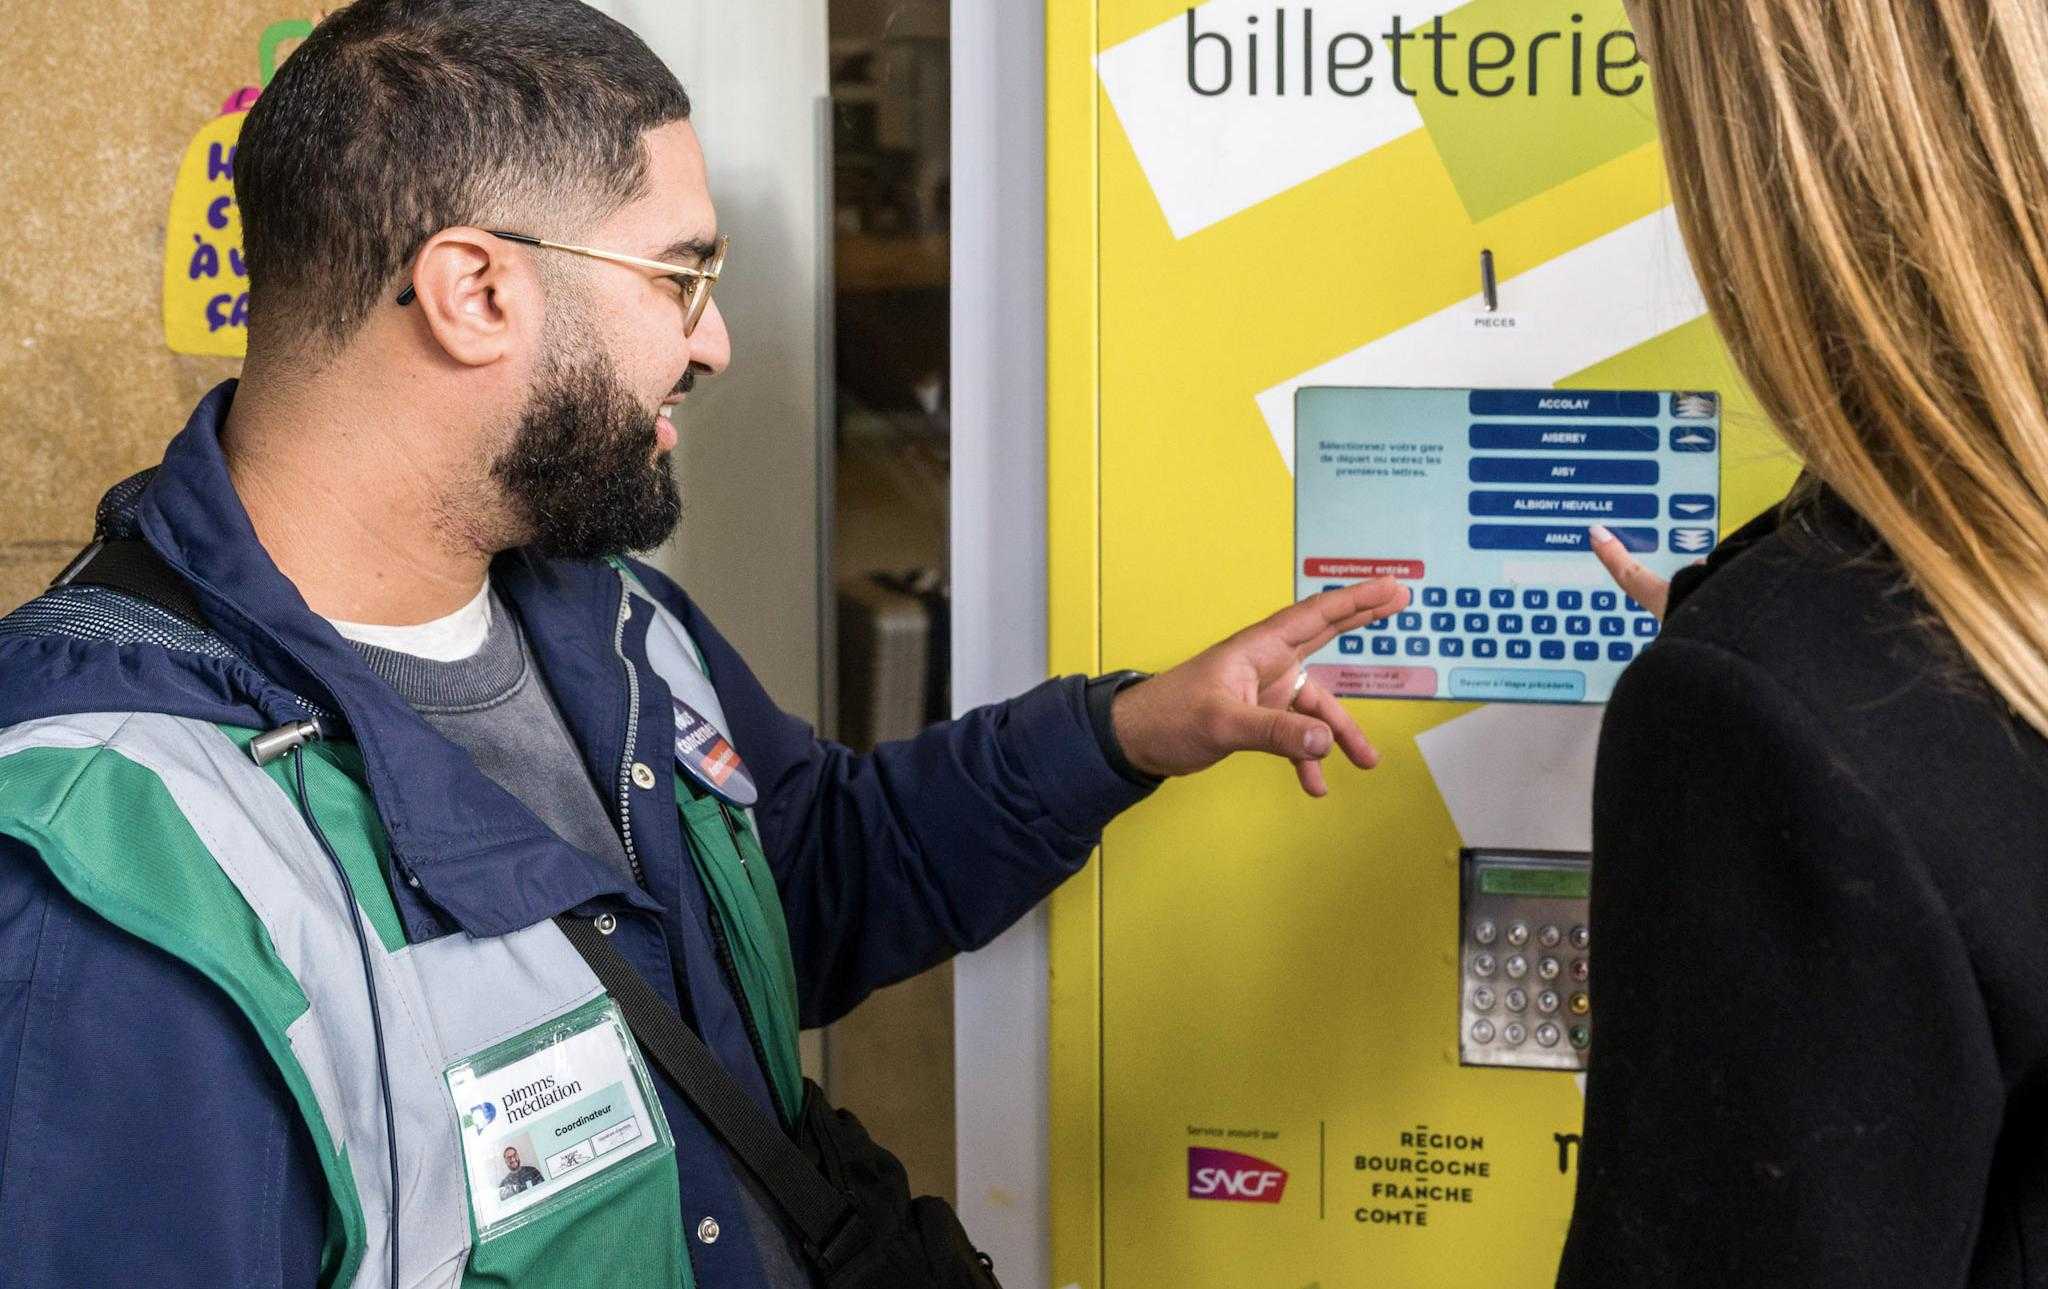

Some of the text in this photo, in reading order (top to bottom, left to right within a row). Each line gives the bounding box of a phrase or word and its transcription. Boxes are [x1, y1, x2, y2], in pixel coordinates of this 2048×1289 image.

[1187, 8, 1645, 97] billetterie
[1474, 318, 1516, 328] PIECES
[1538, 399, 1590, 411] ACCOLAY
[1541, 432, 1587, 444] AISEREY
[1389, 442, 1417, 452] votre
[1420, 444, 1444, 454] gare
[1320, 453, 1333, 463] de
[1390, 455, 1423, 464] entrez
[1426, 455, 1441, 464] les
[1551, 466, 1576, 478] AISY
[1514, 499, 1613, 512] ALBIGNY NEUVILLE
[1545, 533, 1582, 545] AMAZY
[1319, 563, 1373, 575] supprimer
[501, 1074, 555, 1110] pimms
[507, 1079, 583, 1123] médiation
[554, 1104, 612, 1137] Coordinateur
[1192, 1168, 1283, 1197] SNCF
[1372, 1182, 1473, 1203] FRANCHE
